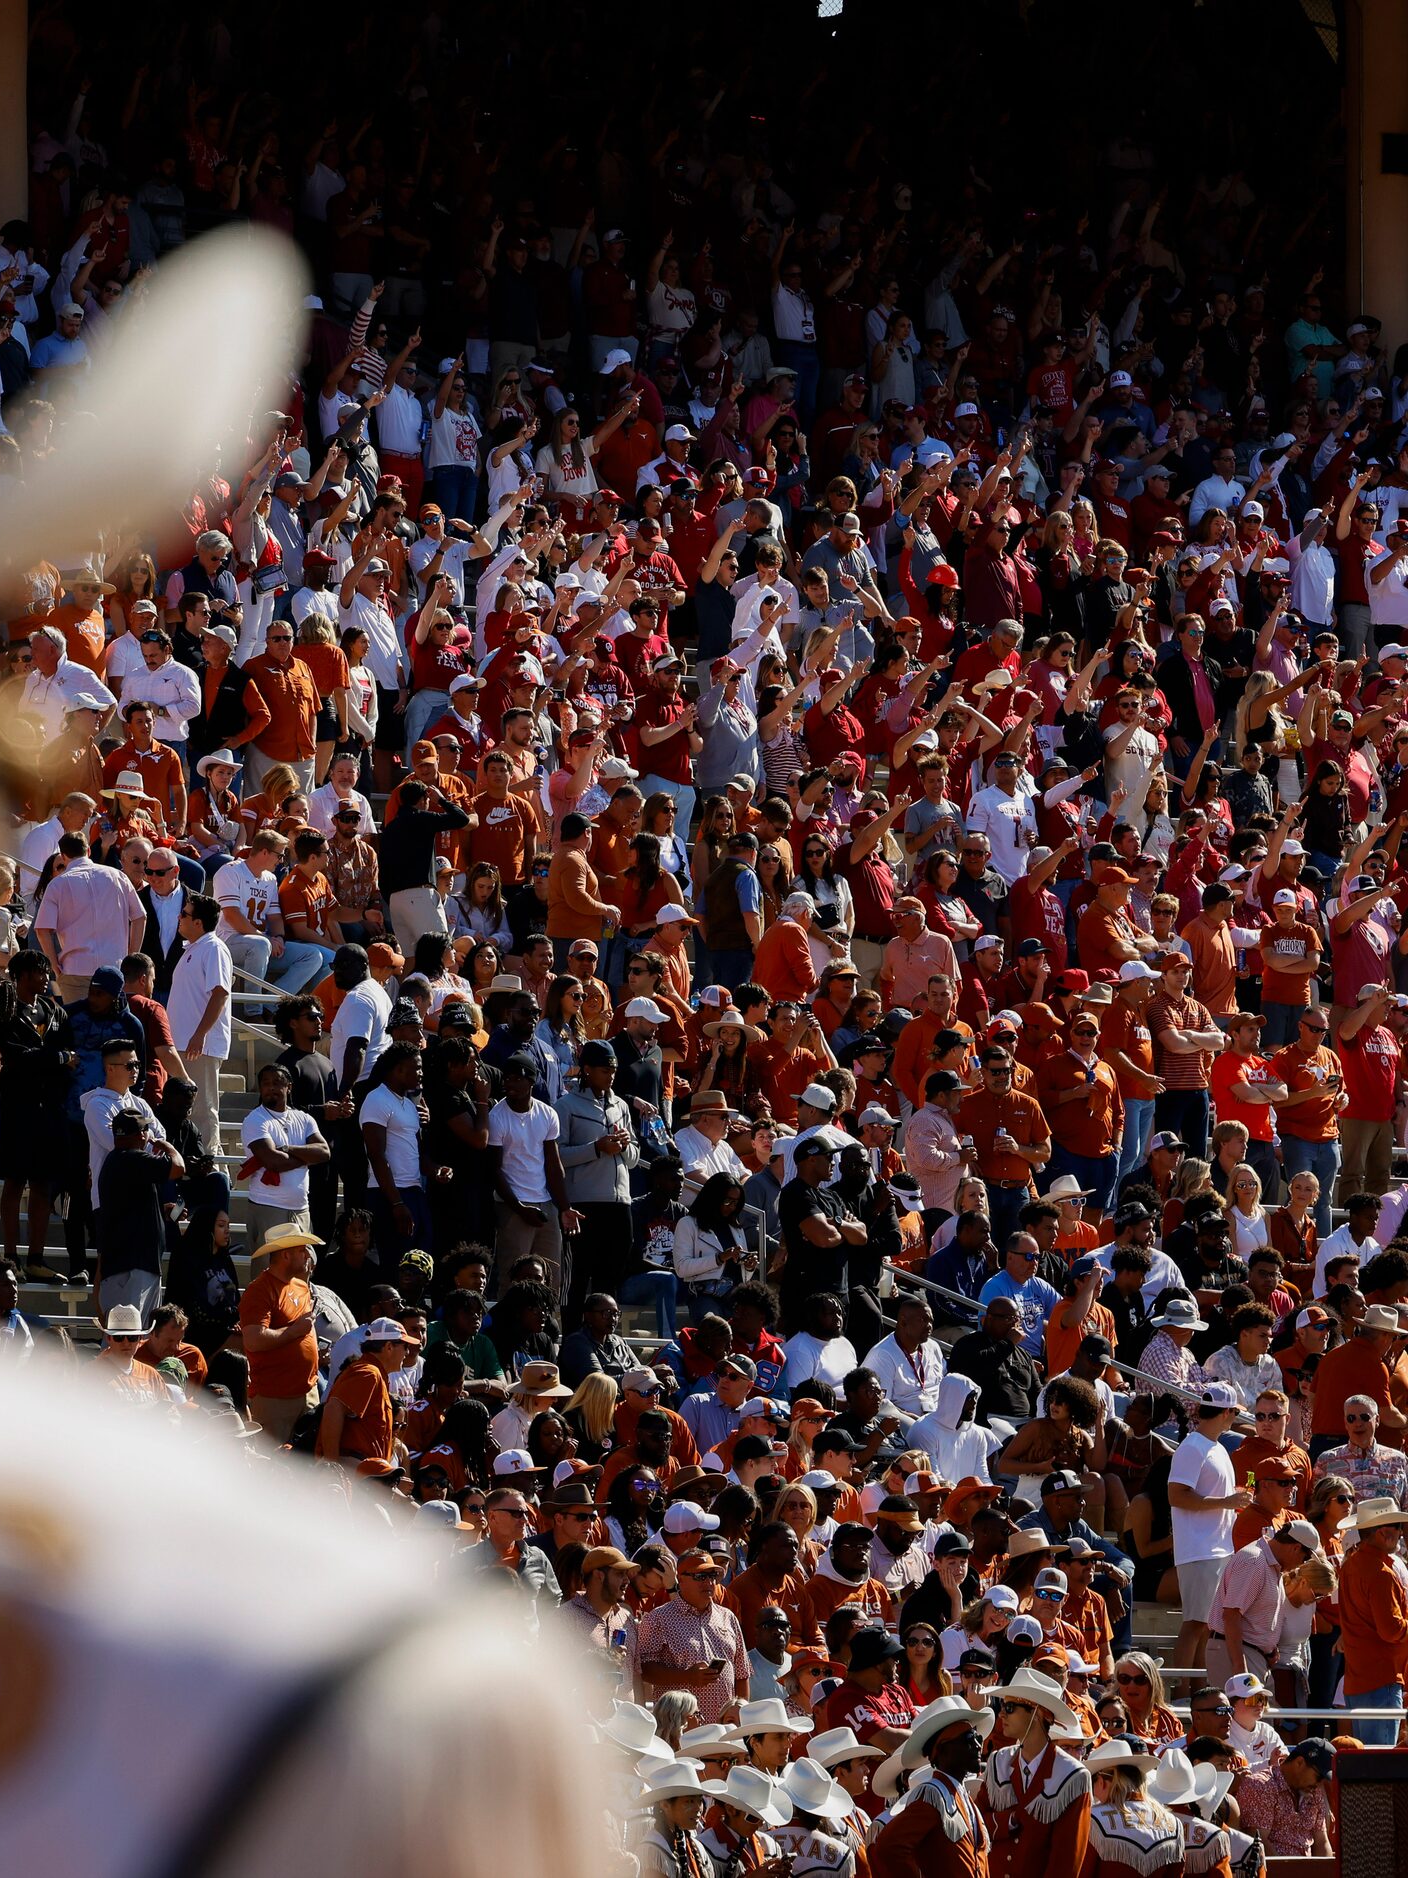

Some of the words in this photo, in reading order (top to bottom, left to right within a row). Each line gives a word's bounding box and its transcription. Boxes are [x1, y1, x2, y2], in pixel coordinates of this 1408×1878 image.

[1111, 374, 1126, 382] OKLA
[633, 565, 669, 583] OKLAHOMA
[491, 807, 514, 817] NIKE
[250, 888, 267, 899] TEXAS
[756, 1360, 781, 1393] S
[510, 1460, 521, 1470] T
[844, 1704, 873, 1732] 14
[775, 1833, 840, 1864] EXAS
